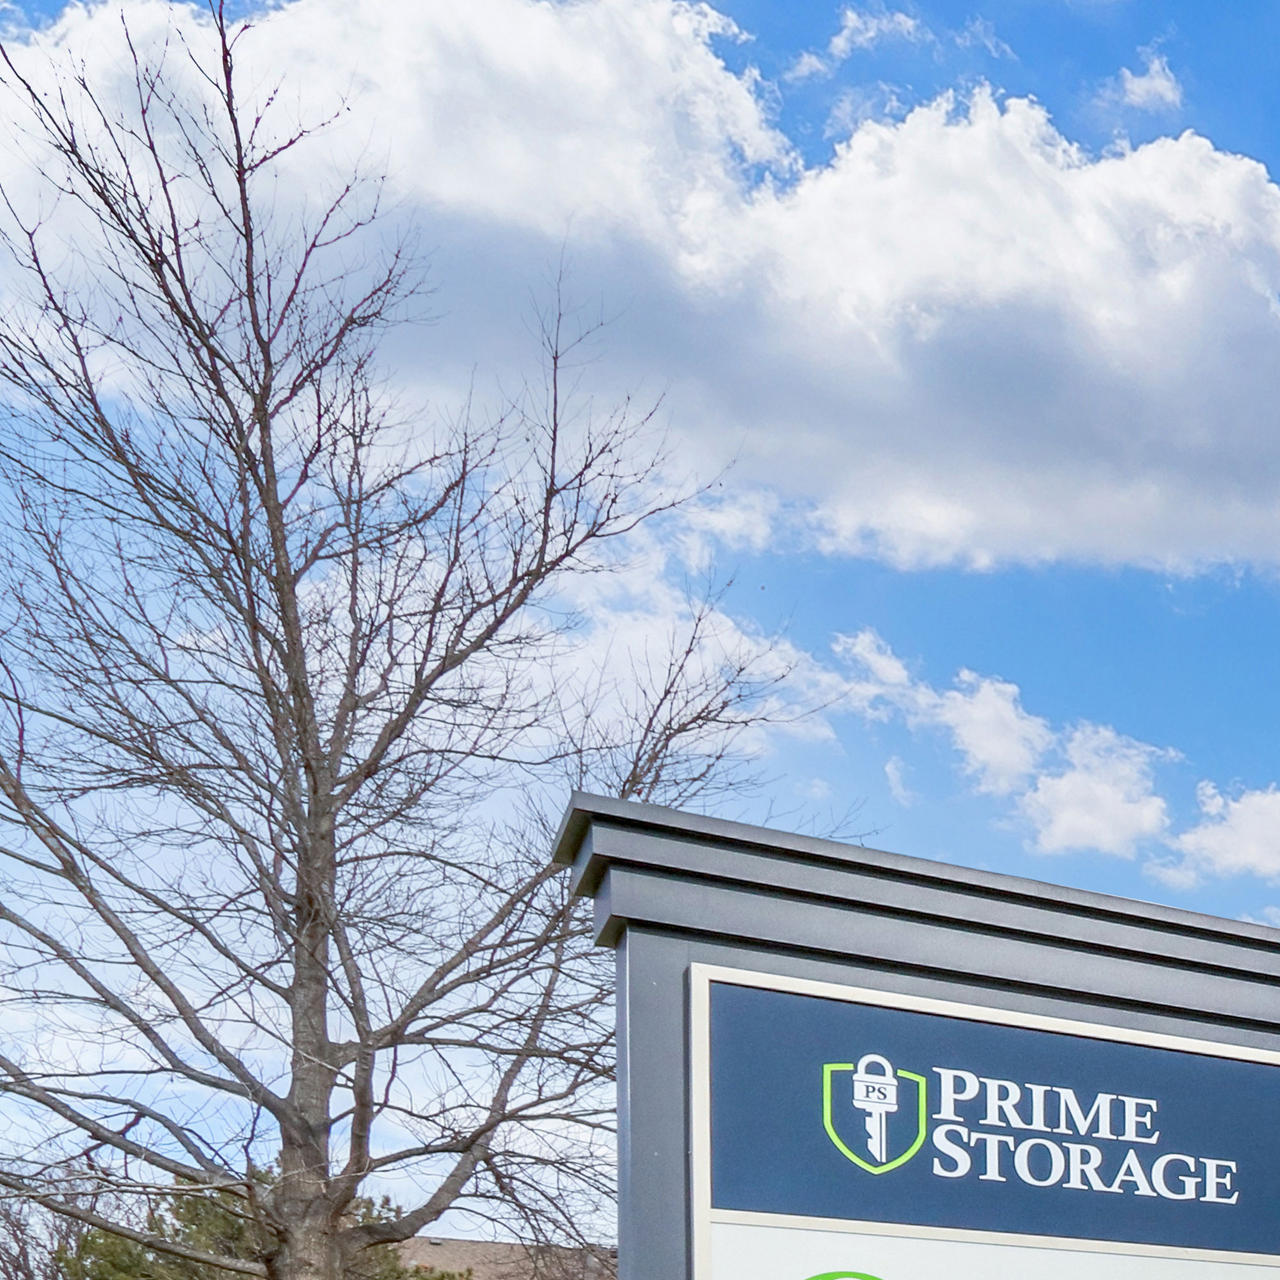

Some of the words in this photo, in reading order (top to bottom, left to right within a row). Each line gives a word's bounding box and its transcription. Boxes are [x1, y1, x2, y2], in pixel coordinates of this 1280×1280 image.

[863, 1084, 888, 1101] PS
[931, 1066, 1160, 1145] PRIME
[932, 1123, 1239, 1205] STORAGE
